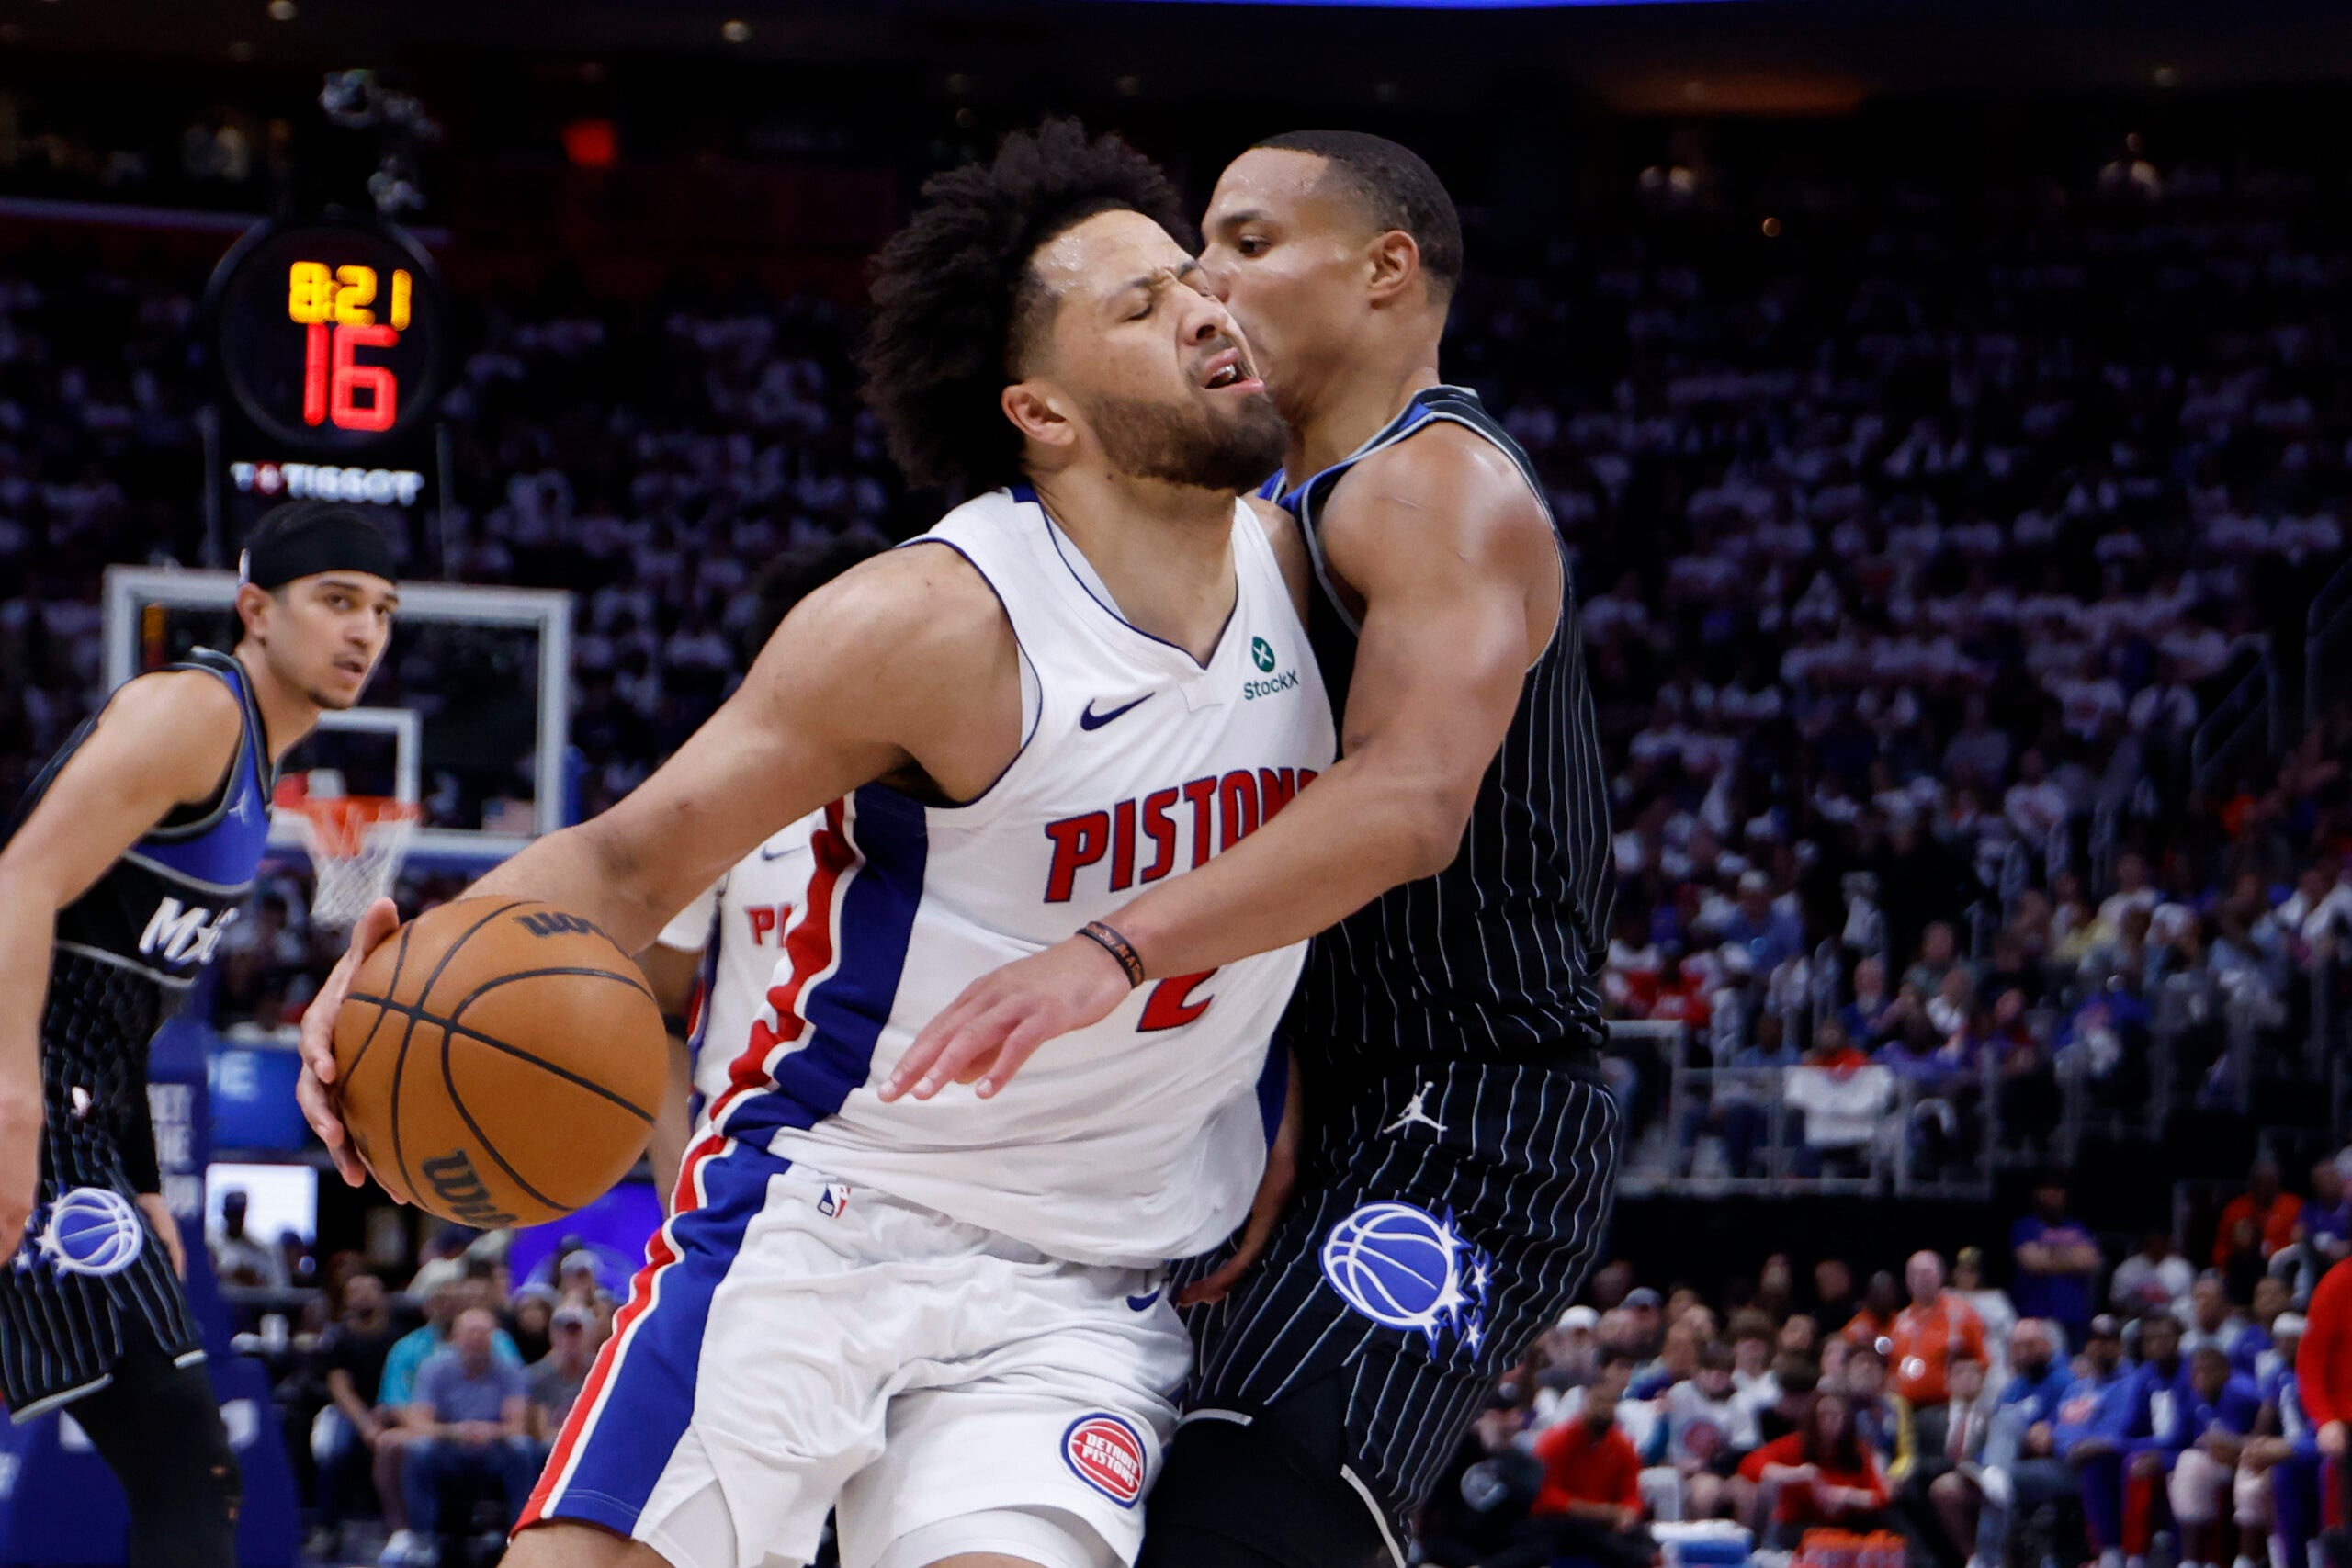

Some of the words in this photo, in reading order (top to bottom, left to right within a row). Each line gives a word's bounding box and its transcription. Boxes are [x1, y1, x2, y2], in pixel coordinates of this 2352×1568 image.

[289, 261, 412, 331] 8:21
[303, 322, 400, 432] 16
[280, 463, 425, 506] TISSOT
[1243, 669, 1299, 701] StockX
[1044, 767, 1318, 903] PISTON
[1081, 1445, 1136, 1488] PISTONS
[1085, 1432, 1139, 1474] DETROIT
